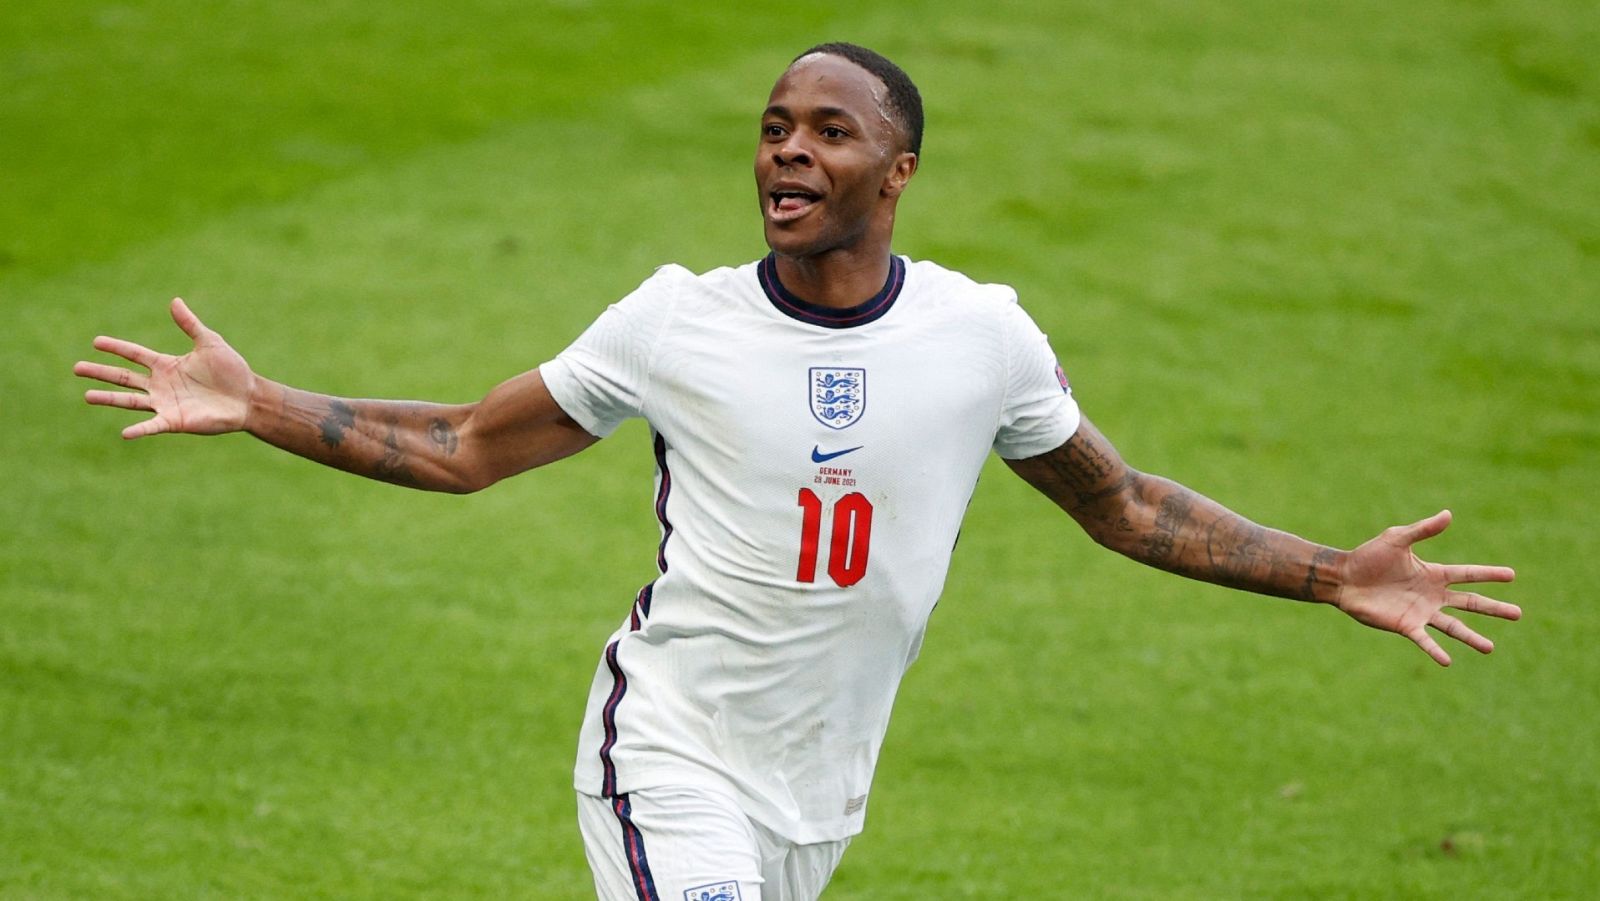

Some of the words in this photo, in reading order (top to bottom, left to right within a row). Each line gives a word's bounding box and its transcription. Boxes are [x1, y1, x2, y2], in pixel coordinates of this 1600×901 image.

[819, 467, 852, 477] GERMANY
[824, 477, 840, 485] JUNE
[796, 487, 874, 587] 10
